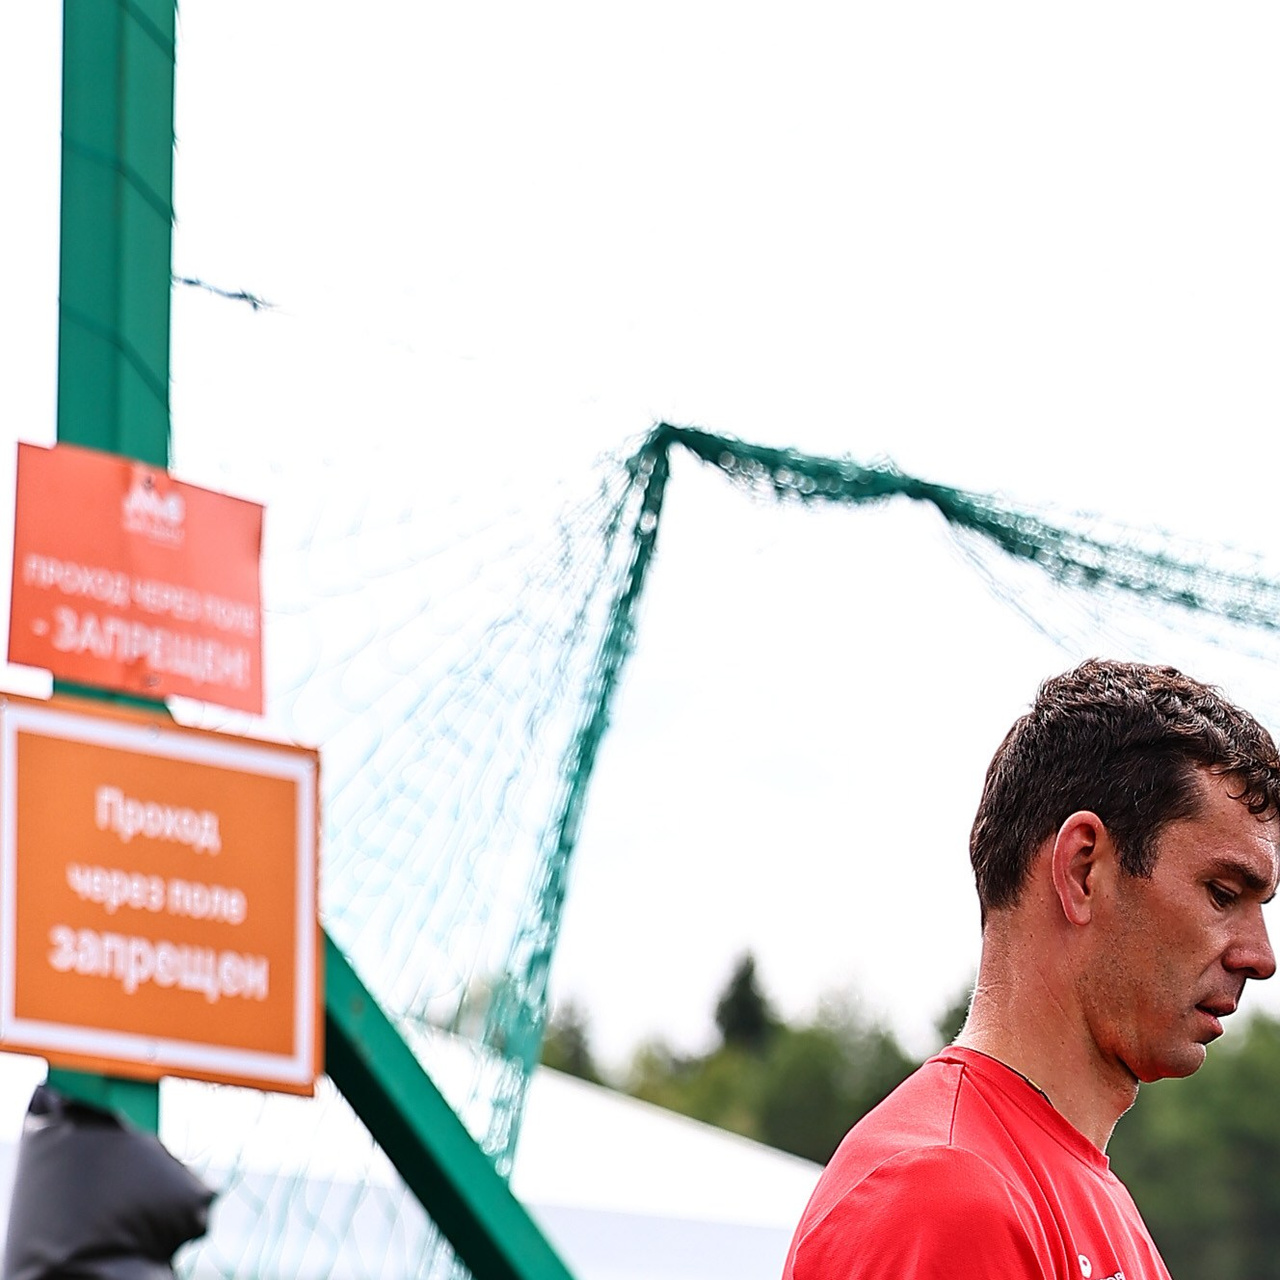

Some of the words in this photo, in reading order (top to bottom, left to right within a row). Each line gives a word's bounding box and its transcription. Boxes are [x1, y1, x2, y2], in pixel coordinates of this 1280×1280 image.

[96, 786, 222, 856] Проход
[66, 863, 166, 914] через
[167, 878, 247, 925] поле
[49, 926, 269, 1003] запрещен
